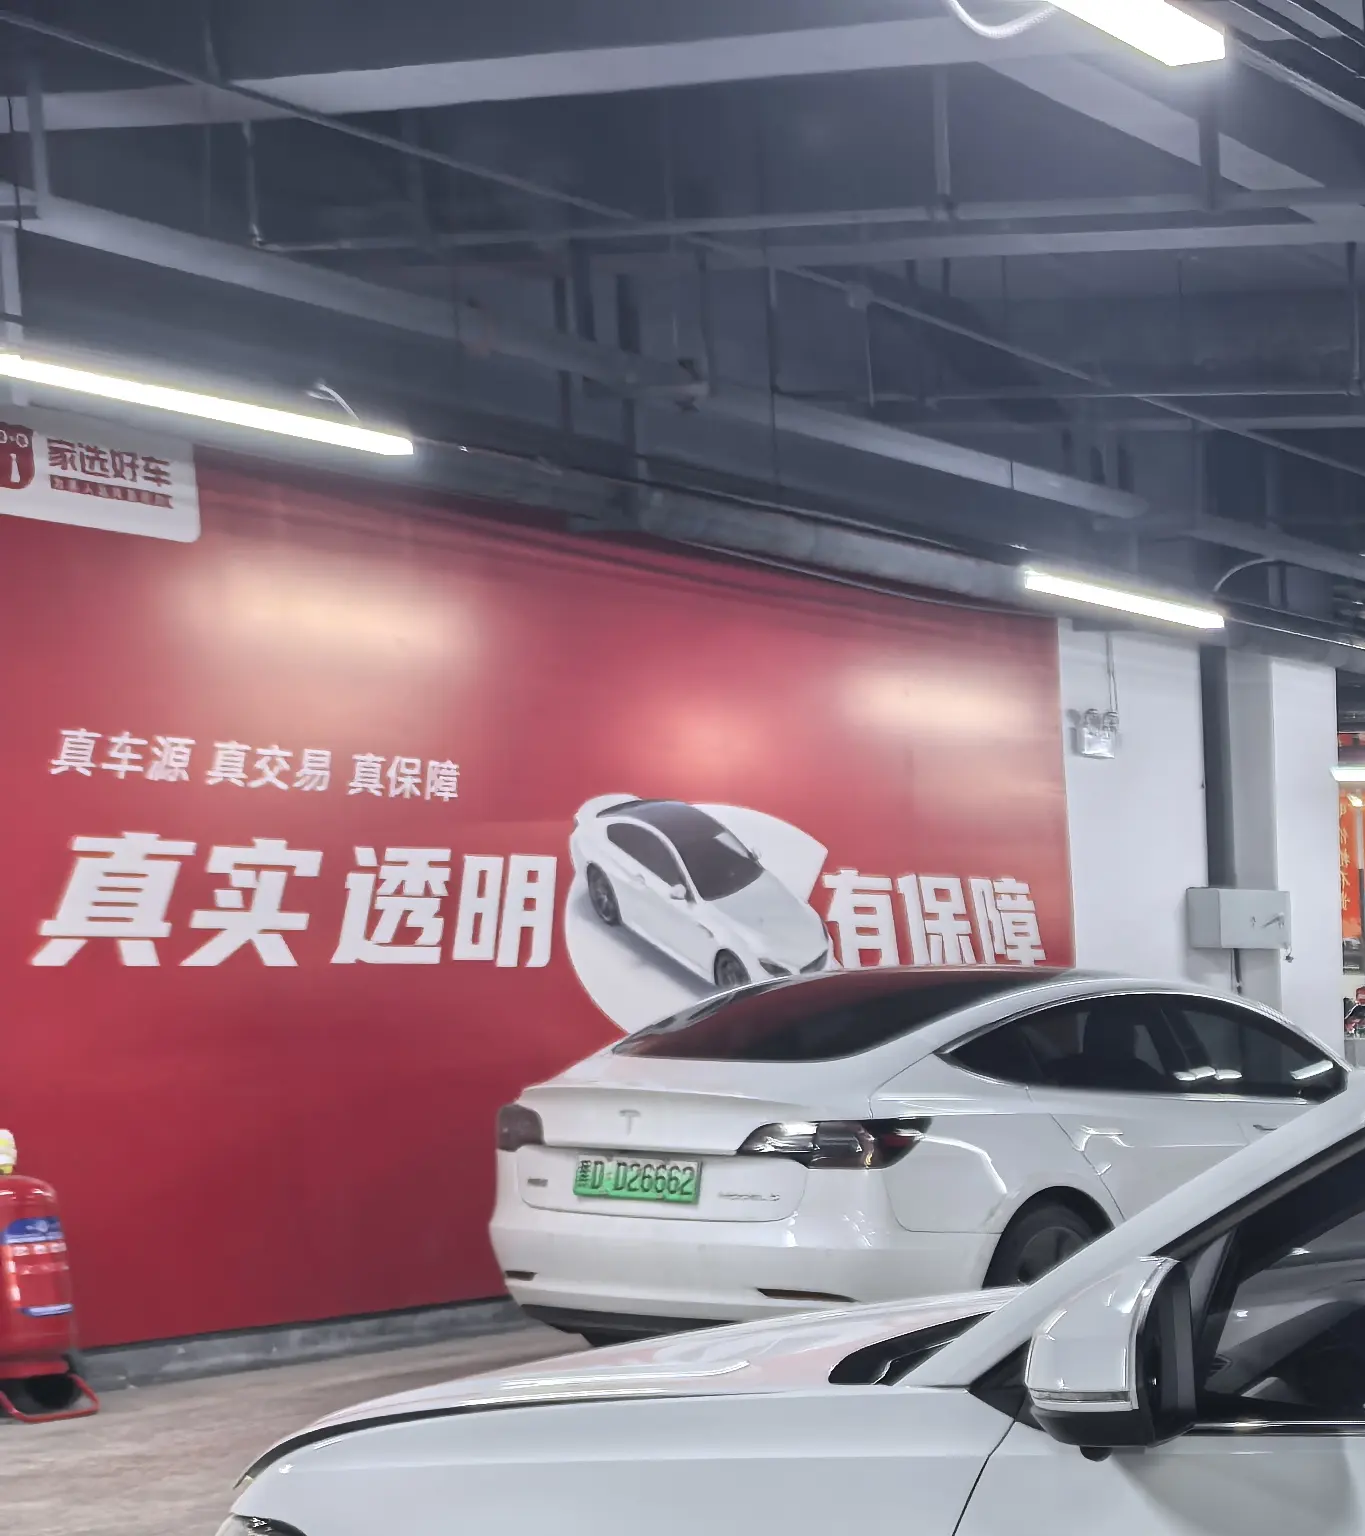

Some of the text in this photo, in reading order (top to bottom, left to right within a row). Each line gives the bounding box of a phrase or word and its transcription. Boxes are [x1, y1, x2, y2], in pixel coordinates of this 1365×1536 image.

[47, 438, 172, 487] 家选好车
[48, 728, 461, 802] 真车源 真交易 真保障
[822, 868, 1047, 967] 有保障
